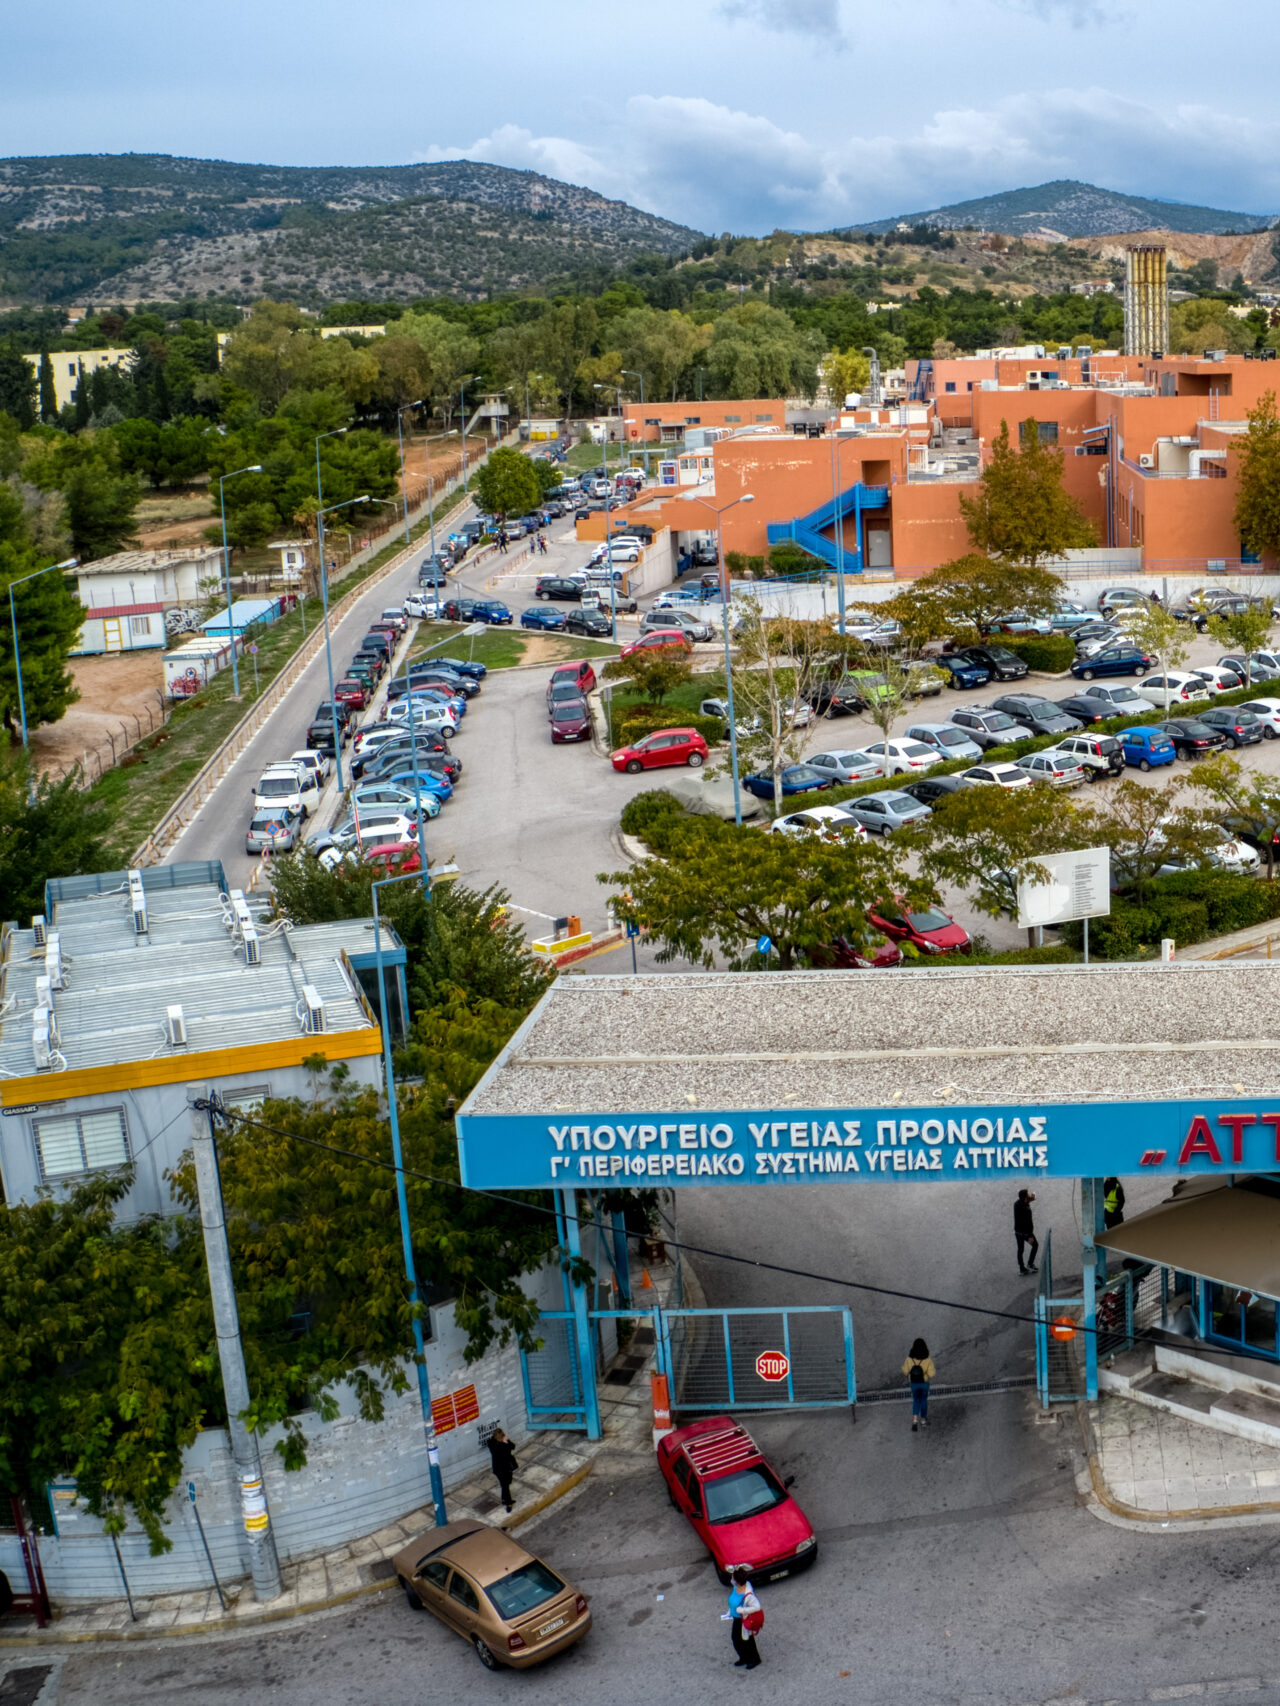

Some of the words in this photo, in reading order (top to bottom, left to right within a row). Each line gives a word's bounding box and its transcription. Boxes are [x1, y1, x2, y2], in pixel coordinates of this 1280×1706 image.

[548, 1123, 734, 1150] ΥΠΟΥΡΓΕΙΟ
[748, 1121, 862, 1148] ΥΓΕΙΑΣ
[876, 1116, 1047, 1146] ΠΡΟΝΟΙΑΣ
[579, 1153, 745, 1177] ΠΕΡΙΦΕΡΕΙΑΚΟ
[755, 1151, 860, 1174] ΣΥΣΤΗΜΑ
[865, 1149, 943, 1172] ΥΓΕΙΑΣ
[953, 1146, 1048, 1169] ΑΤΤΙΚΗΣ
[759, 1359, 787, 1375] STOP
